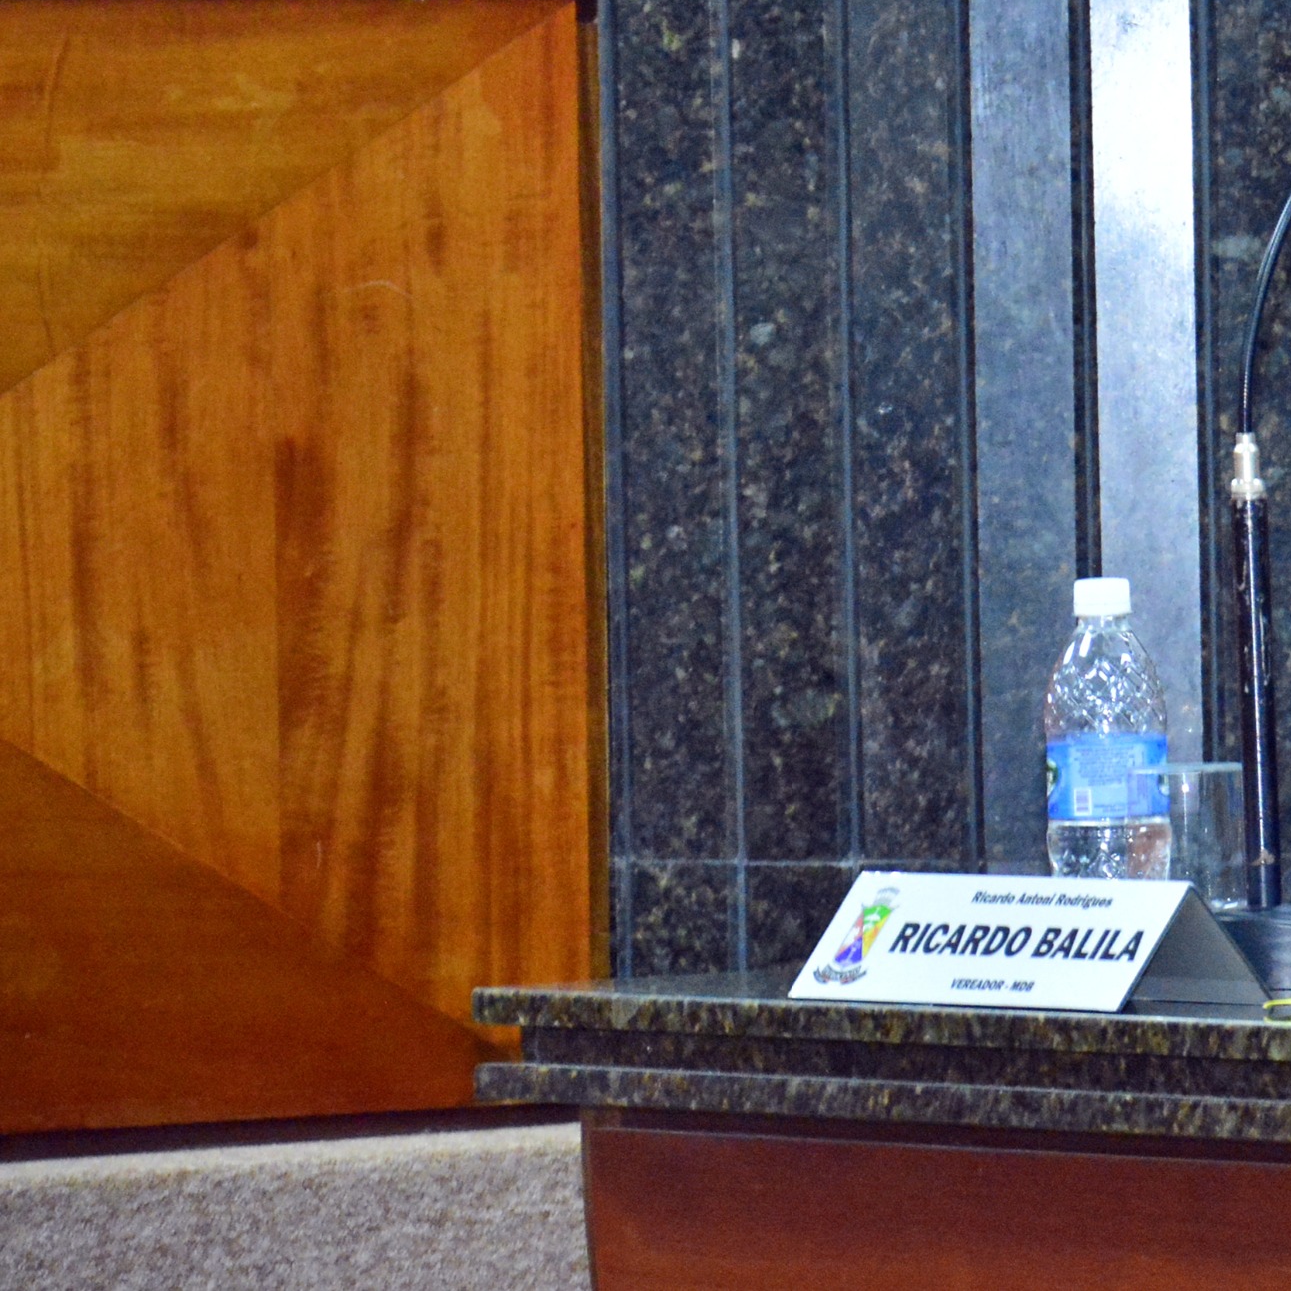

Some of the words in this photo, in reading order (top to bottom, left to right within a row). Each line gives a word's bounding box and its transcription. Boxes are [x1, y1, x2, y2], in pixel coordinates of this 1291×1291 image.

[972, 890, 1015, 905] Ricardo
[1016, 892, 1054, 906] Antoni
[1055, 893, 1113, 910] Rodrigues
[889, 922, 1033, 957] RICARDO
[1031, 926, 1145, 962] BALILA
[950, 978, 1004, 991] VEREADOR
[1010, 980, 1035, 992] MDB
